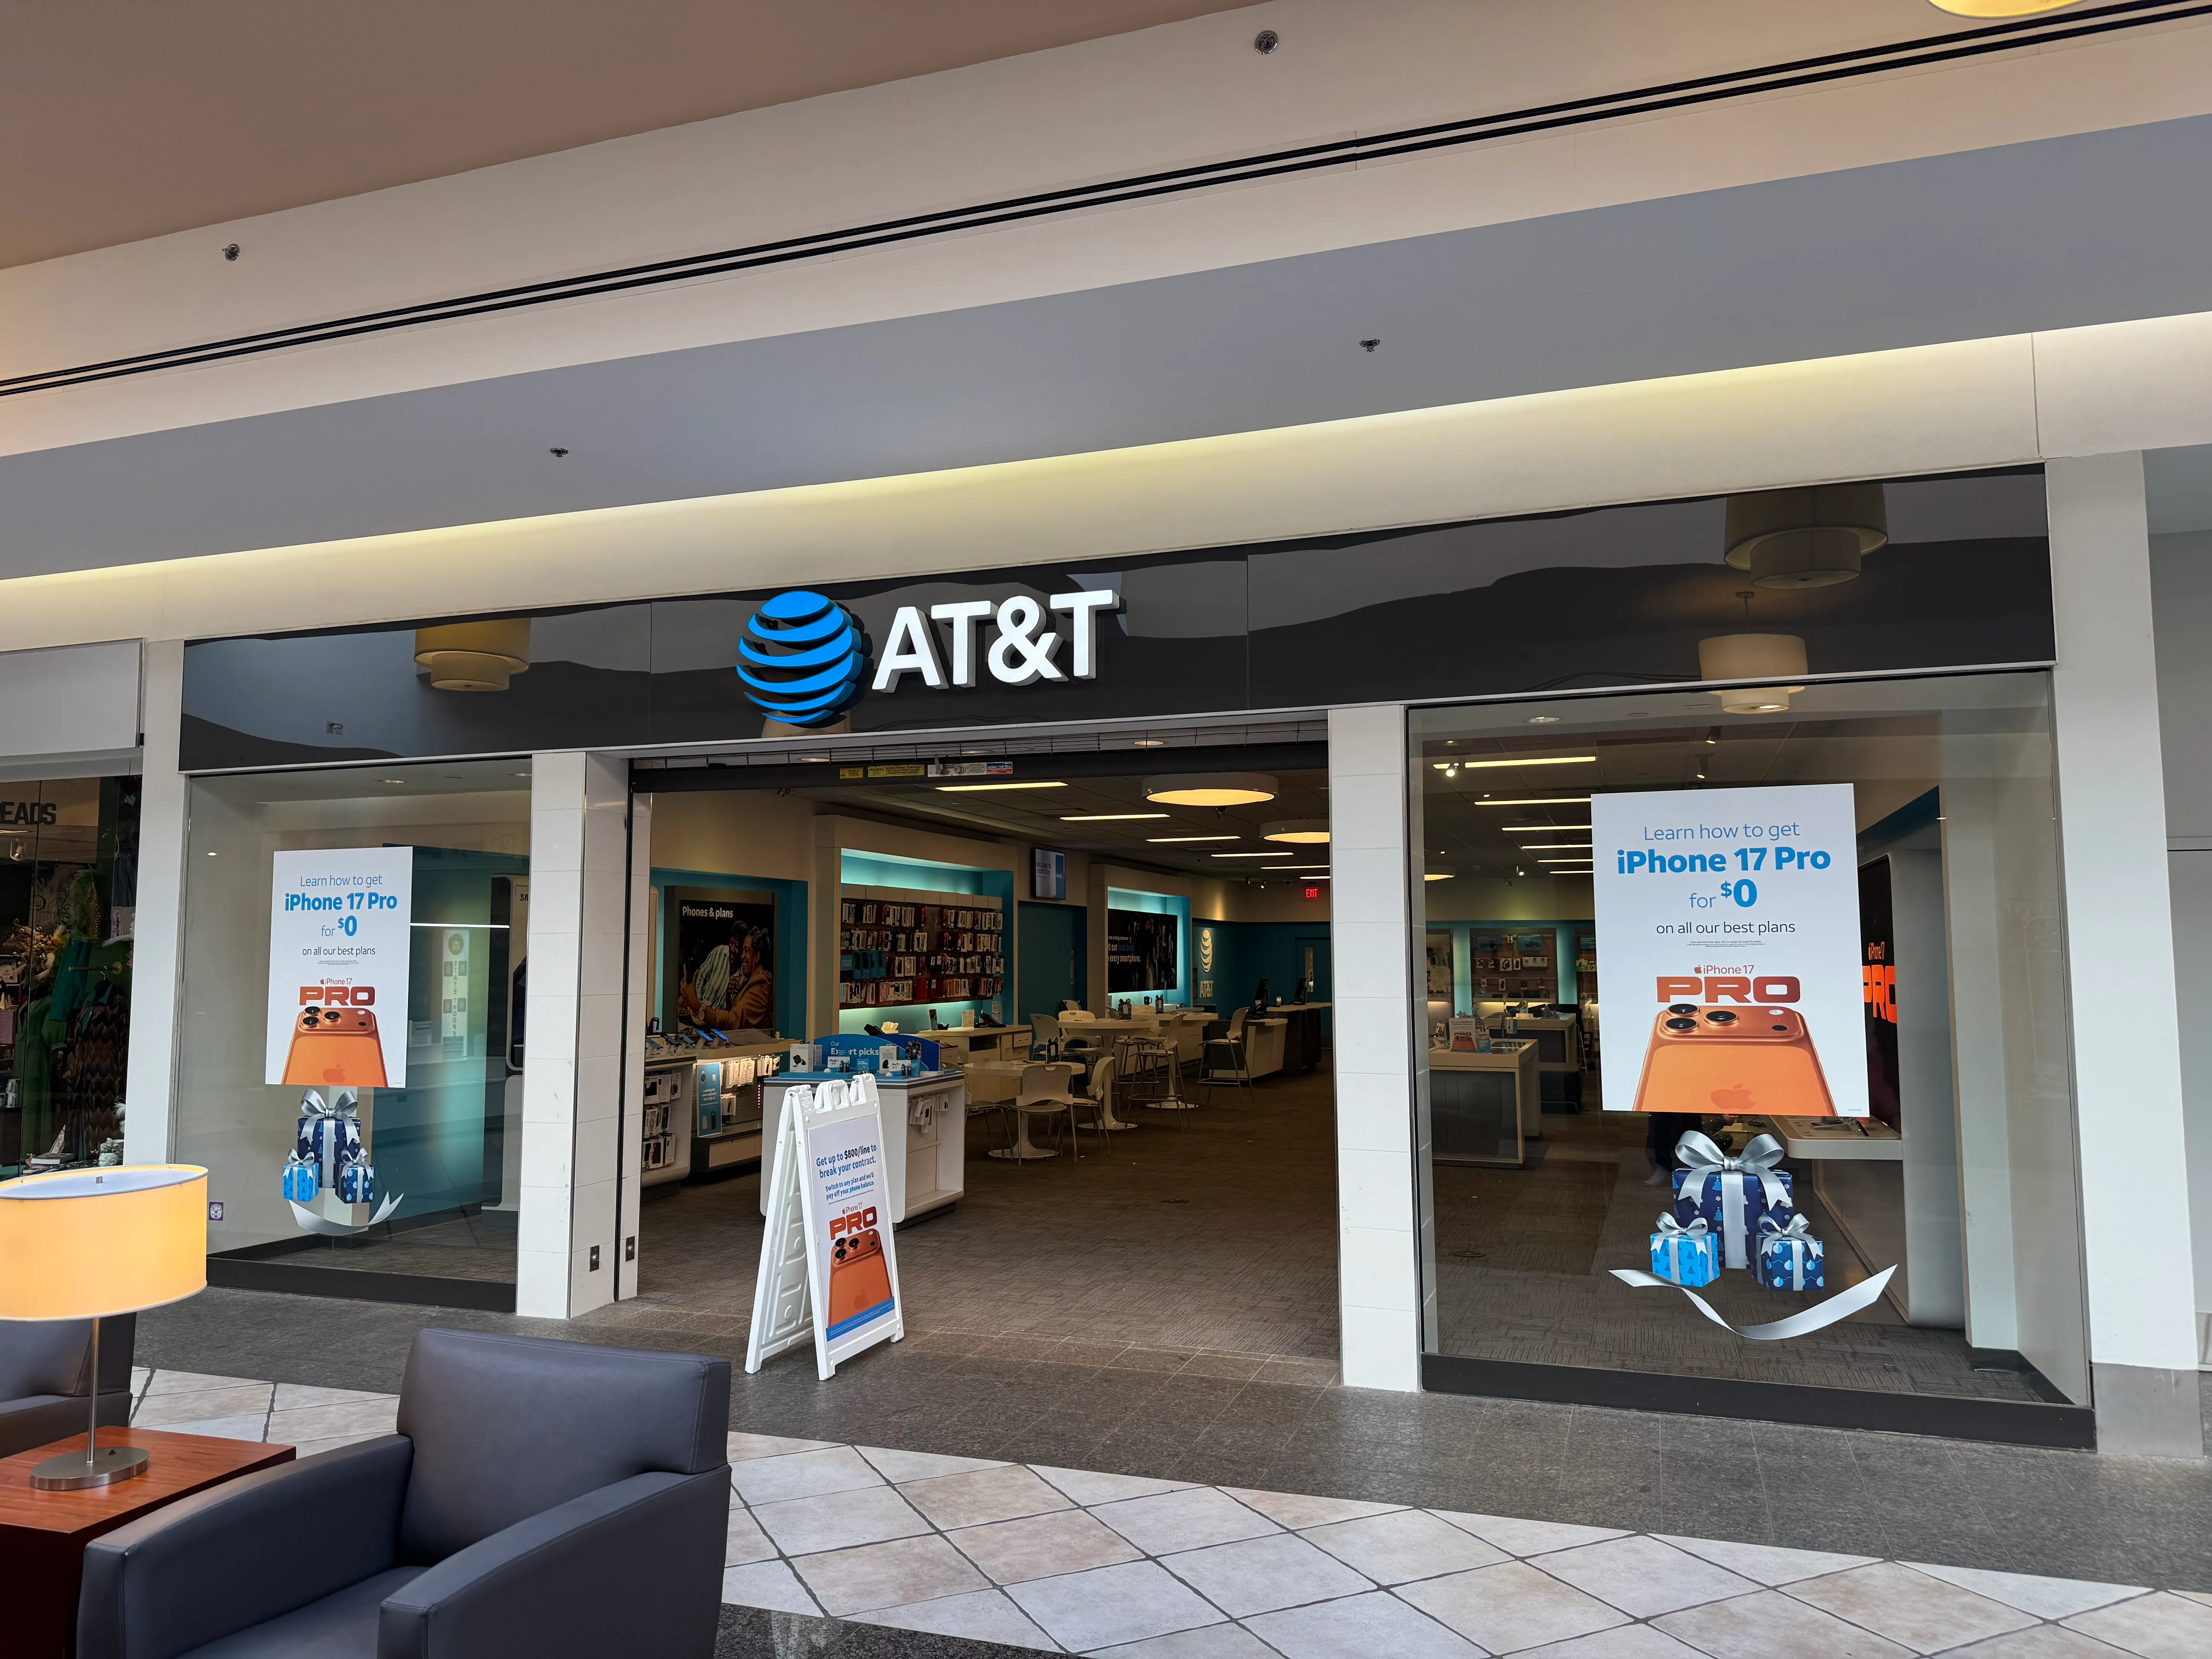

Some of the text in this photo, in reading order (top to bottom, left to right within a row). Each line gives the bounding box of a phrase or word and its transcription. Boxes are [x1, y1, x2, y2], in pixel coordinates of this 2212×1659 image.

[872, 589, 1119, 693] AT&T
[0, 801, 57, 825] EADS
[1644, 822, 1800, 841] Learn how to get
[1617, 847, 1831, 874] iPhone 17 Pro
[301, 874, 382, 888] Learn how to get
[285, 892, 397, 911] iPhone 17 Pro
[1306, 889, 1317, 897] EXIT
[1689, 879, 1757, 908] for $0
[682, 905, 733, 920] Phones & plans
[321, 915, 357, 937] for $0
[1656, 921, 1795, 936] on all our best plans
[302, 947, 312, 955] on
[323, 947, 336, 955] our
[338, 946, 354, 955] best
[356, 946, 376, 957] plans
[1870, 942, 1881, 960] iPhone
[1704, 965, 1754, 974] iPhone 17
[299, 986, 375, 1006] PRO
[1200, 980, 1214, 998] AT&T
[1656, 976, 1801, 1003] PRO
[1862, 965, 1897, 1024] PRO
[859, 1048, 879, 1057] picks
[816, 1156, 827, 1167] Get
[828, 1156, 836, 1165] up
[837, 1153, 843, 1161] to
[844, 1146, 870, 1160] $800/line
[819, 1155, 876, 1178] break your contract.
[826, 1183, 838, 1192] Switch
[841, 1188, 849, 1197] your
[849, 1185, 860, 1194] phone
[860, 1180, 874, 1188] balance.
[846, 1205, 858, 1214] iPhone
[830, 1206, 877, 1241] PRO
